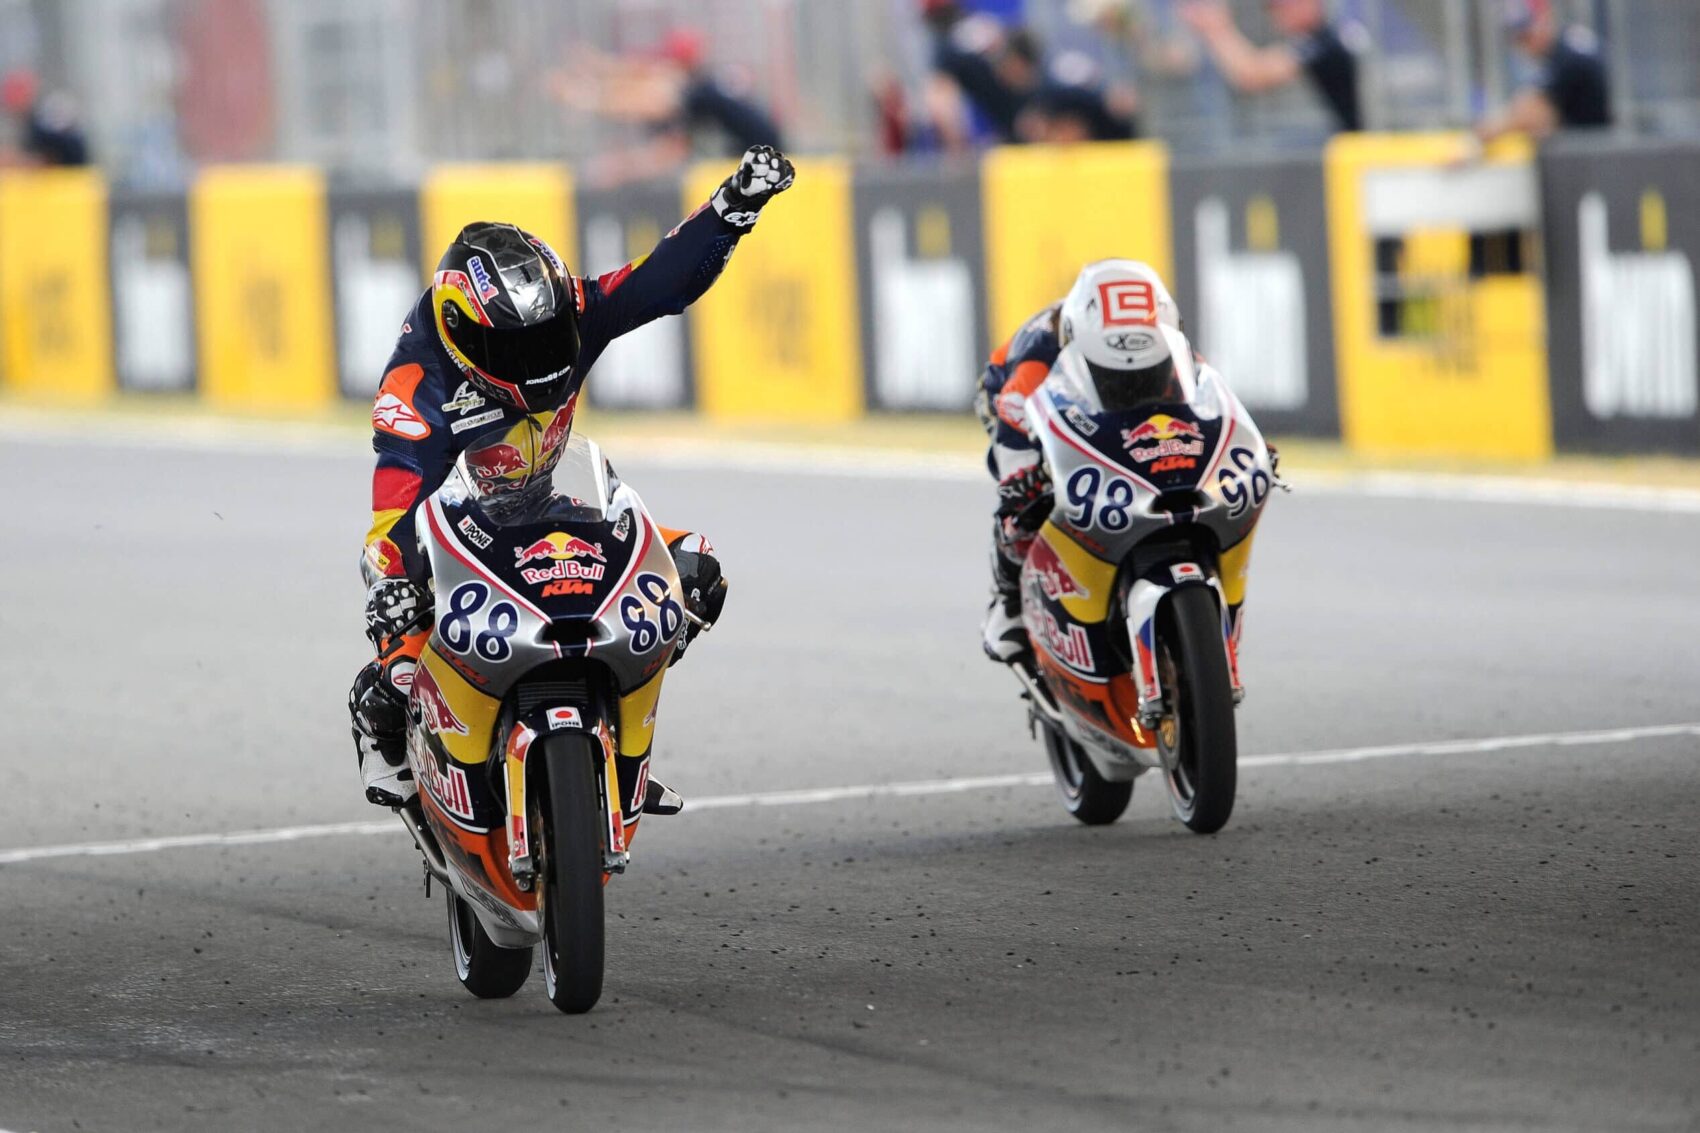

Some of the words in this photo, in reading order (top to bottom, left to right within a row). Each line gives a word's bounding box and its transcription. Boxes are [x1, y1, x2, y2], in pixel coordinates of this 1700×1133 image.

[1151, 456, 1196, 474] KTM
[1066, 466, 1135, 532] 98
[464, 522, 490, 547] IPONE
[521, 560, 564, 584] Red
[566, 560, 605, 580] Bull
[541, 580, 593, 598] KTM
[438, 581, 518, 663] 88
[619, 572, 684, 655] 88
